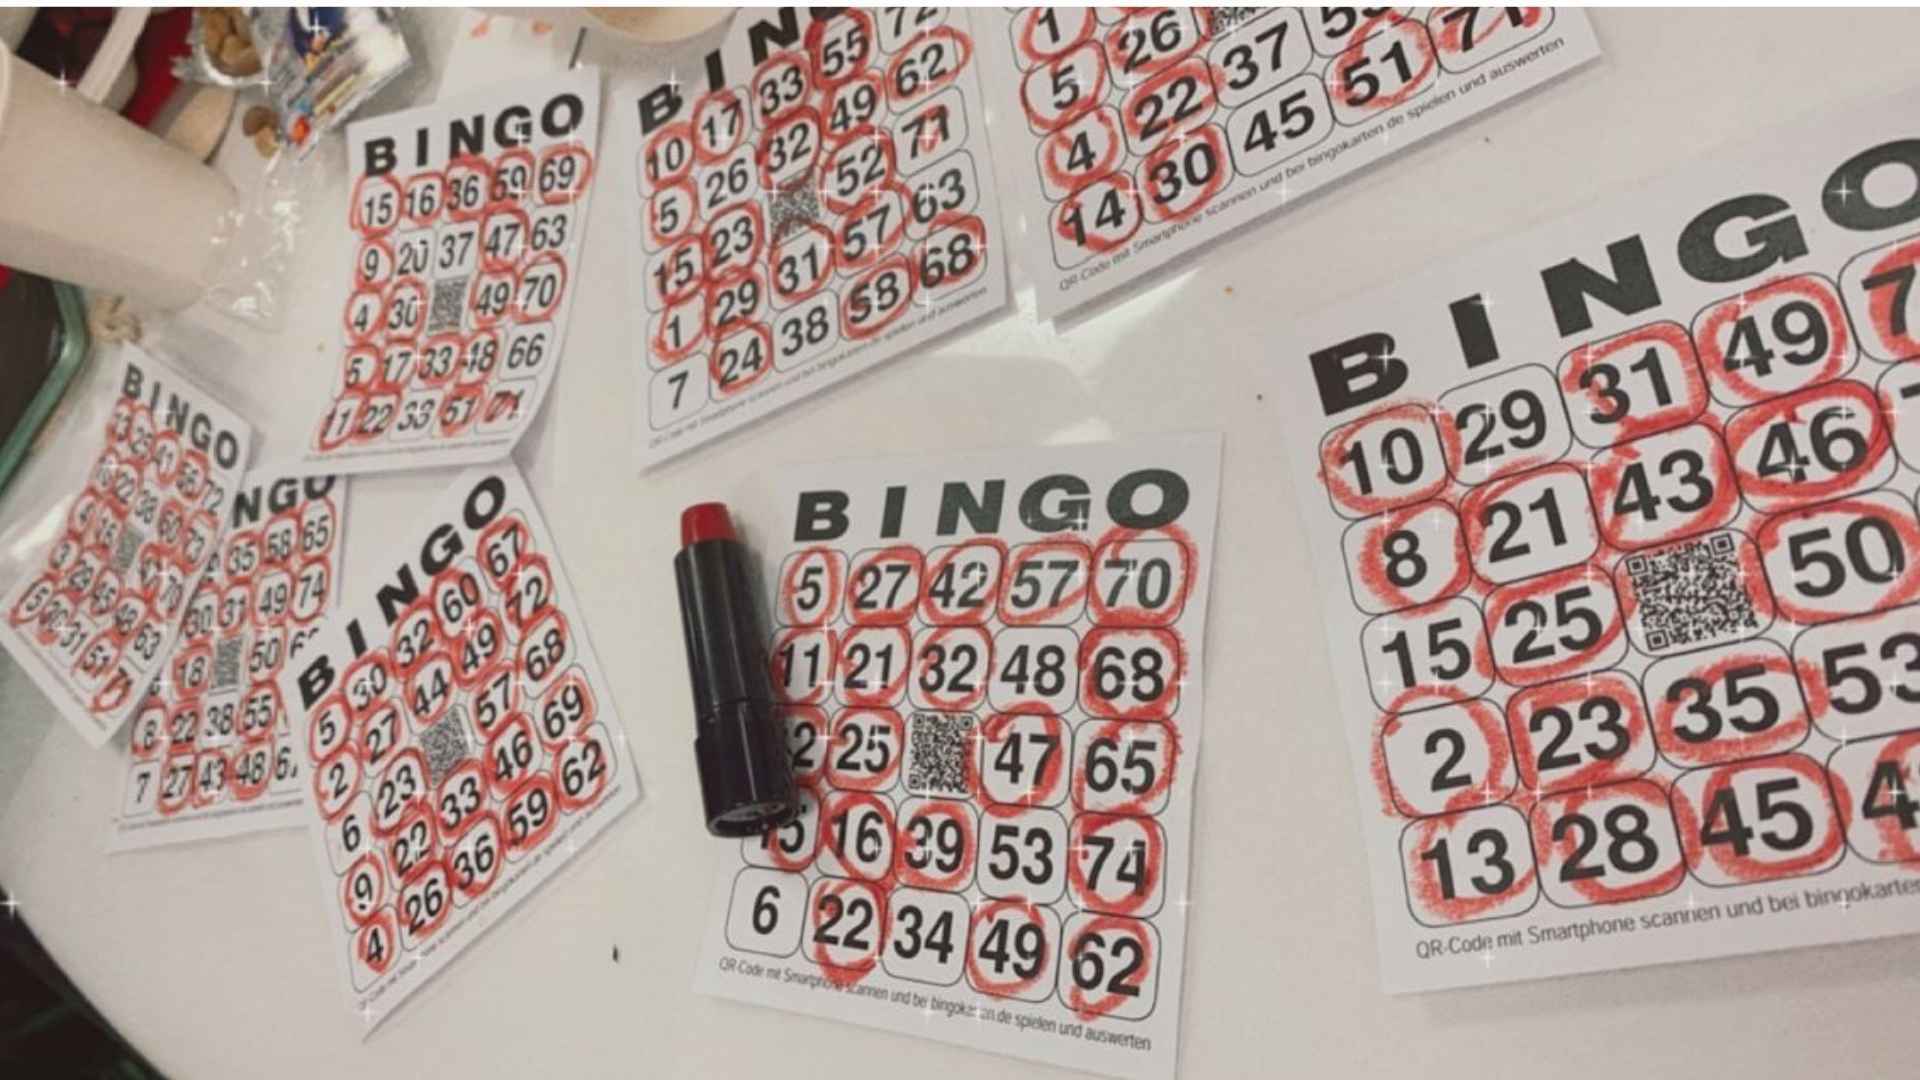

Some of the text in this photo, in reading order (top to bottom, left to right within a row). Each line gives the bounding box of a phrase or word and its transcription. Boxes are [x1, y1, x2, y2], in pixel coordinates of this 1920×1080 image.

[1038, 7, 1181, 70] 1 26
[1052, 23, 1291, 138] 5 22 37
[648, 27, 868, 181] 10 17 33 55
[661, 44, 947, 233] 5 26 32 49 62
[1066, 41, 1412, 203] 4 30 45 51
[365, 155, 575, 226] 15 16 36 59 69
[654, 106, 950, 295] 15 23 52 71
[1066, 190, 1126, 246] 14
[354, 274, 556, 331] 4 30 49 70
[364, 214, 567, 280] 9 20 37 47 63
[668, 168, 965, 347] 1 29 31 57 63
[383, 332, 545, 384] 17 33 48 66
[668, 233, 975, 409] 7 24 38 58 68
[360, 396, 473, 435] 22 51
[1343, 300, 1831, 496] 10 29 31 49
[303, 515, 330, 550] 65
[1382, 407, 1867, 591] 8 21 43 46
[260, 582, 287, 615] 49
[299, 570, 325, 607] 74
[319, 522, 520, 747] 5 30 32 60 67
[797, 558, 1172, 611] 5 27 42 57 70
[1382, 517, 1906, 689] 15 25 50
[205, 698, 271, 736] 38 55
[329, 576, 545, 798] 2 27 44 49 72
[781, 643, 1164, 701] 11 21 32 48 68
[135, 751, 265, 803] 7 48
[342, 629, 564, 852] 6 23 57 68
[393, 685, 583, 875] 22 33 46 69
[836, 722, 1156, 794] 25 47 65
[1423, 664, 1780, 793] 2 23 35
[366, 740, 606, 963] 4 26 36 59 62
[832, 810, 1147, 897] 16 39 53 74
[1420, 778, 1814, 900] 13 28 45
[752, 886, 1145, 997] 6 22 34 49 62
[1416, 935, 1493, 960] QR-Code
[1497, 927, 1523, 947] mit
[1528, 911, 1634, 946] Smartphone
[1641, 904, 1720, 928] scannen
[1726, 897, 1763, 919] und
[1768, 891, 1800, 912] bei
[1059, 1022, 1082, 1037] und
[1085, 1026, 1151, 1051] auswerten
